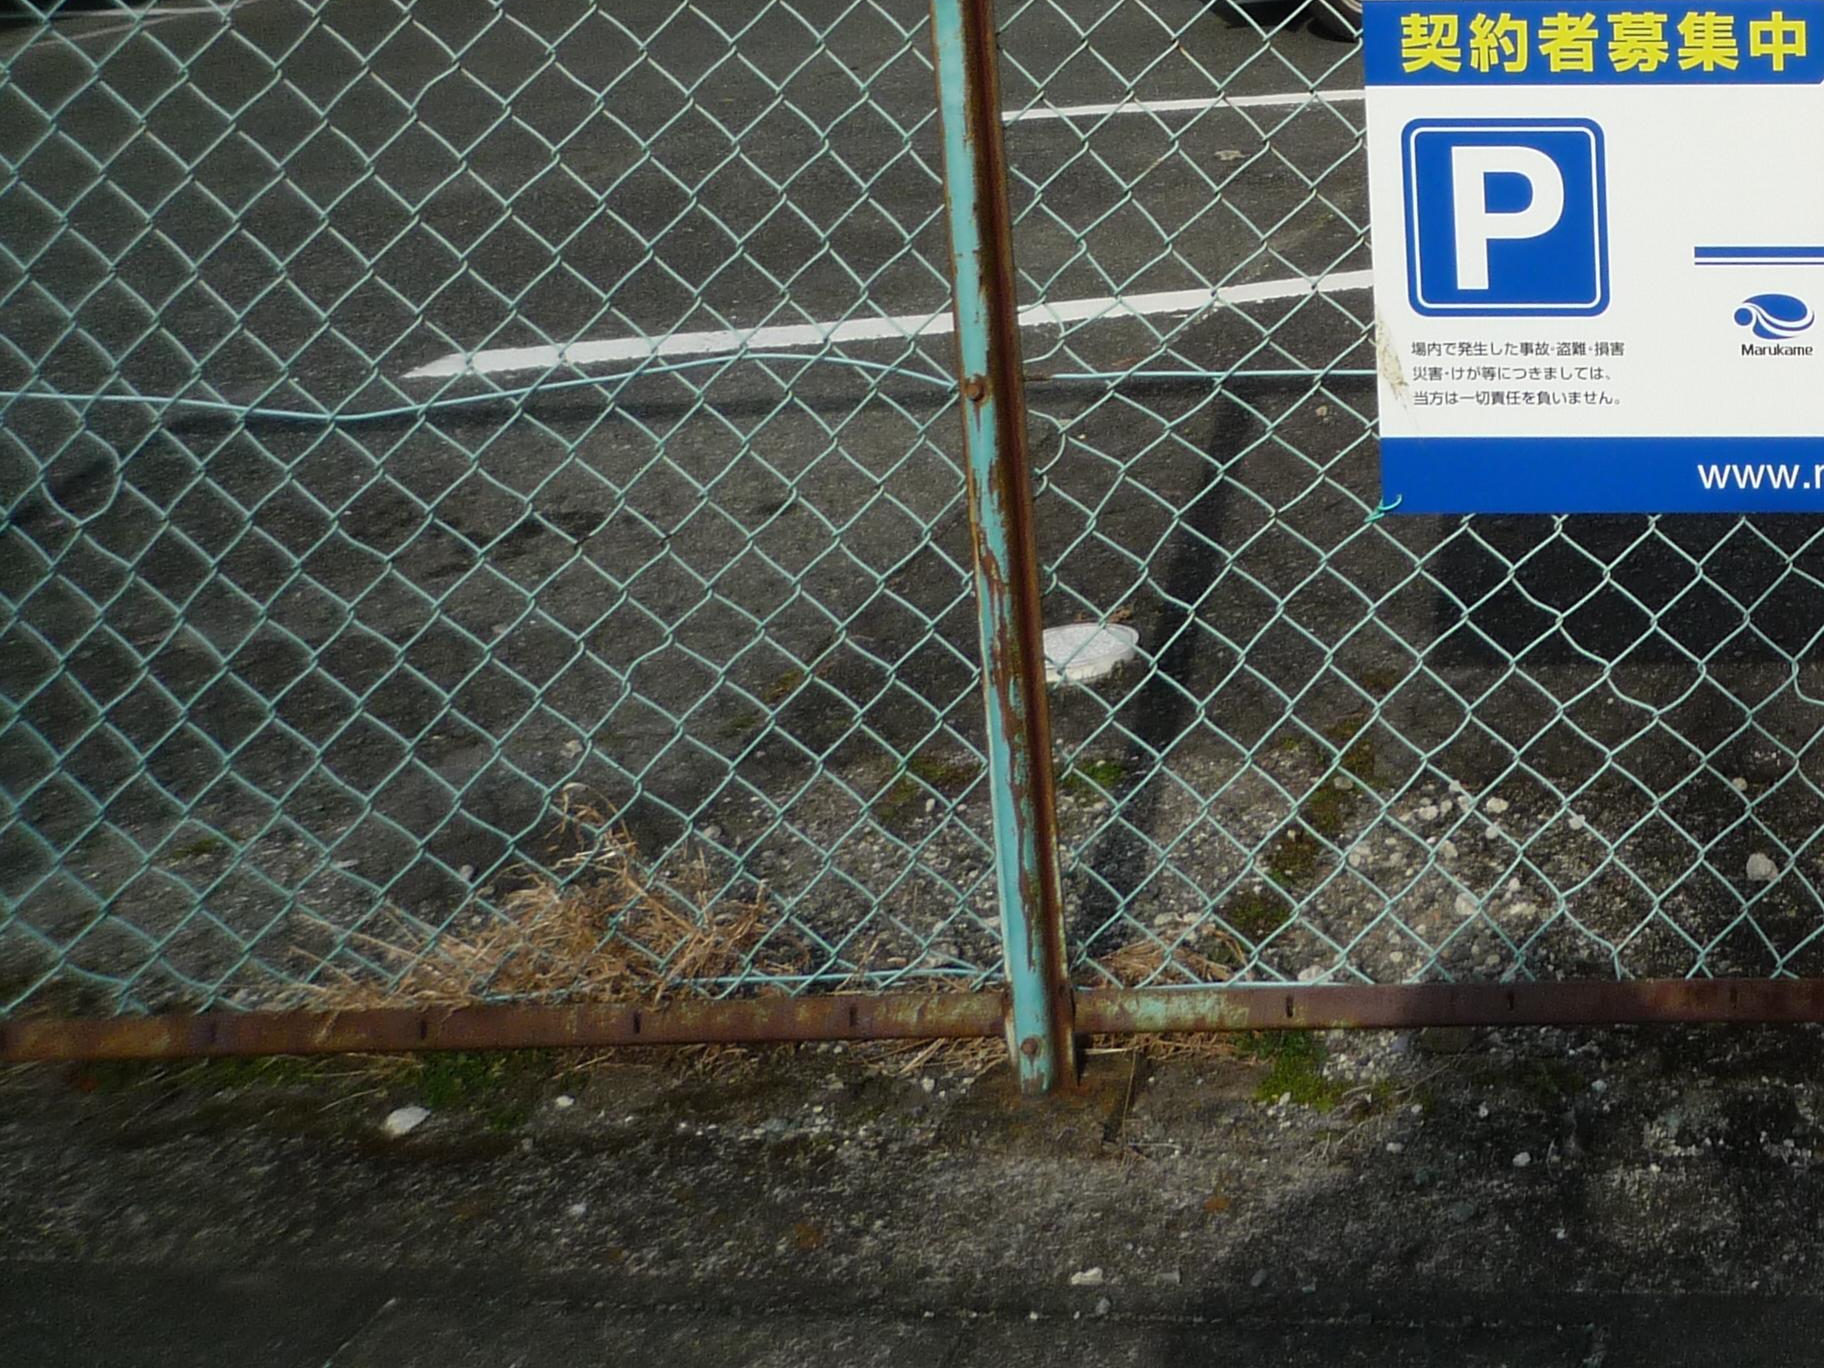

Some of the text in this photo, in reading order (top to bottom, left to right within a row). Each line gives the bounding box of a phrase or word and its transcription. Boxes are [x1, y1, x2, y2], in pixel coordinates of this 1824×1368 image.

[1399, 10, 1808, 74] 契約者募集中
[1451, 146, 1565, 290] P
[1741, 343, 1814, 356] Marukame
[1413, 390, 1621, 406] 当方は一切責任を負いません。
